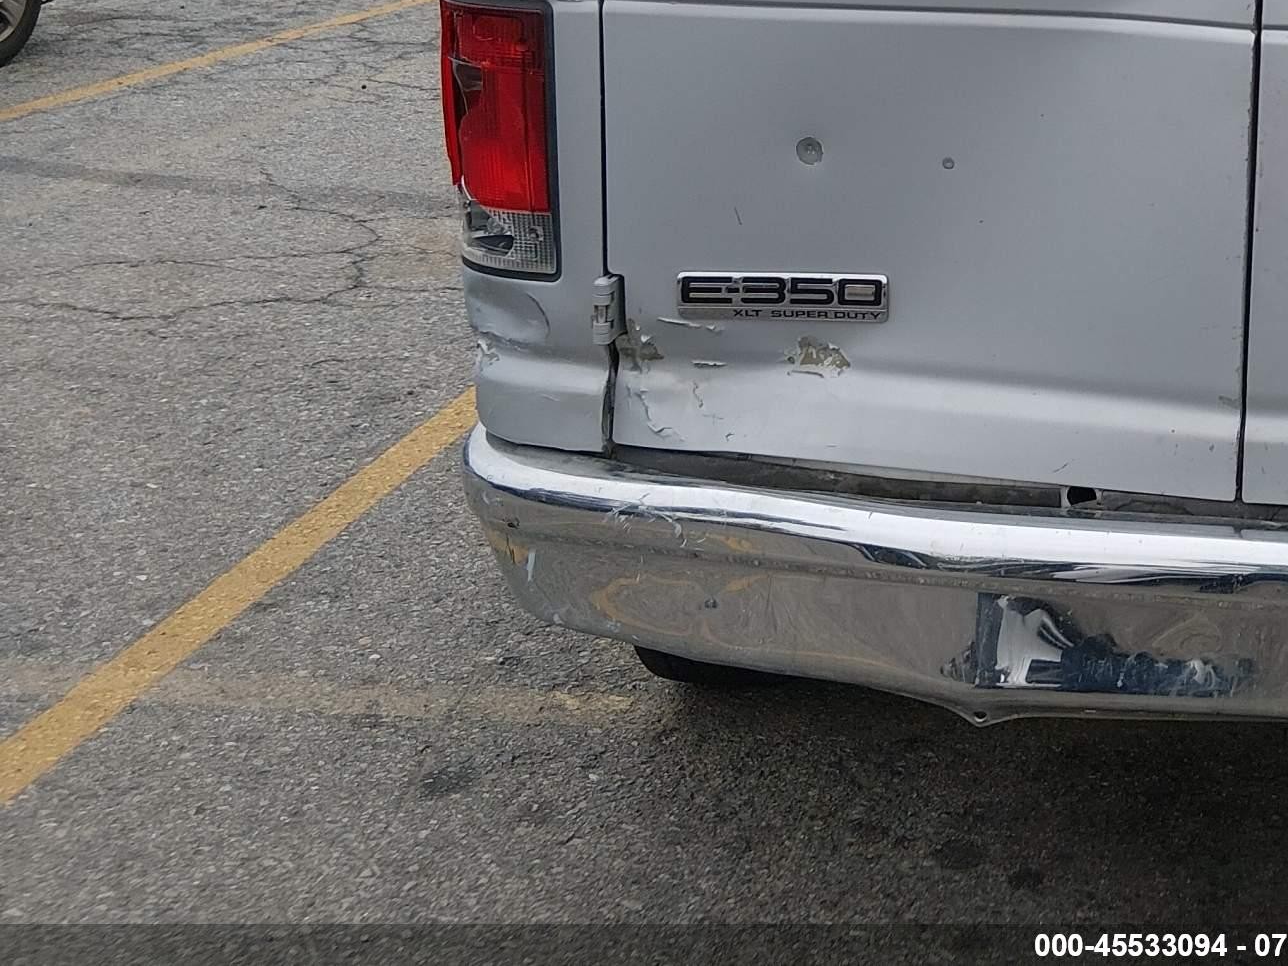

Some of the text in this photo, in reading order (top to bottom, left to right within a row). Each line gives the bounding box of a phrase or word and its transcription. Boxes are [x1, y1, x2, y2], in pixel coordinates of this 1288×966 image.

[681, 276, 882, 306] E-350
[733, 309, 881, 320] XLT SUPER DUTY
